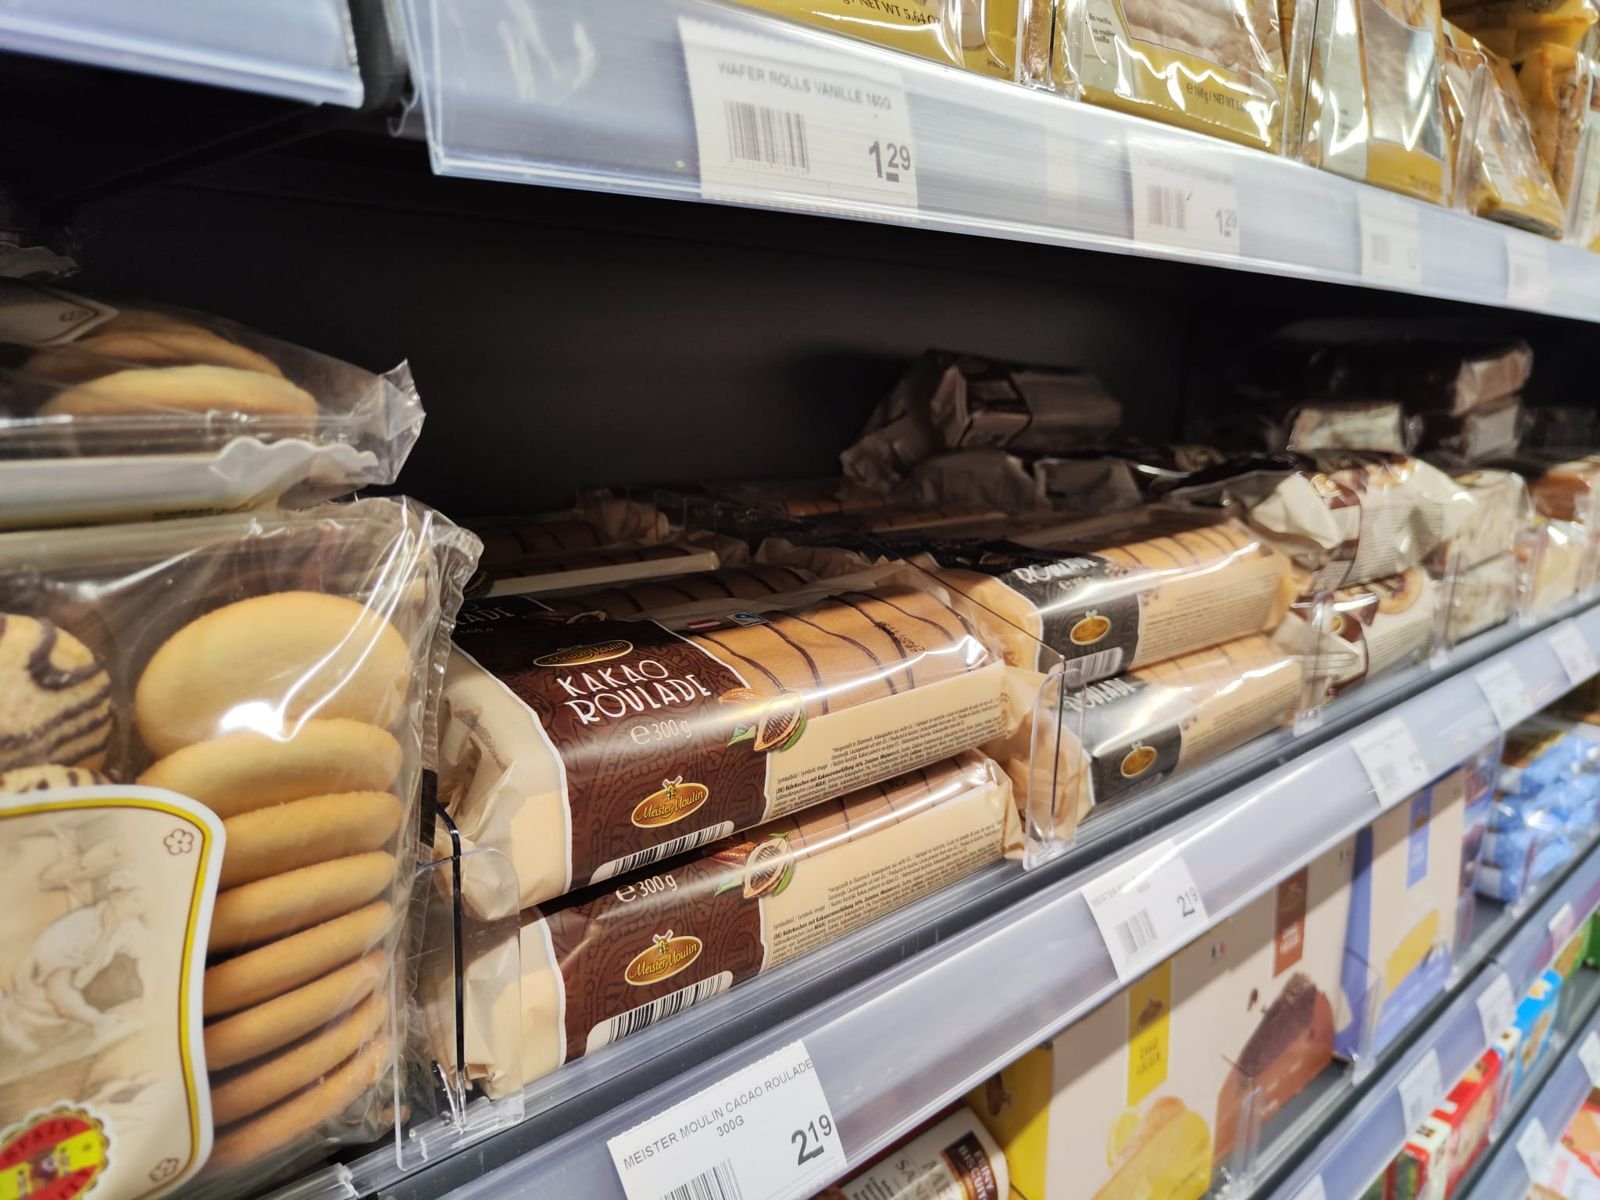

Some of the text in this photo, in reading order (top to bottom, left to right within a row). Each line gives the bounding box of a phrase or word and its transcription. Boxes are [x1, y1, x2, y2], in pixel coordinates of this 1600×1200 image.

[881, 1, 901, 17] WT
[718, 61, 765, 82] WAFER
[769, 71, 811, 93] ROLLS
[813, 80, 863, 104] VANILLE
[557, 659, 669, 698] KAKAO
[564, 673, 712, 725] ROULADE
[636, 790, 704, 821] Meister Moulin
[629, 943, 697, 978] Meister Moulin
[622, 1058, 814, 1171] MEISTER MOULIN CACAO ROULADE
[716, 1114, 745, 1137] 300G
